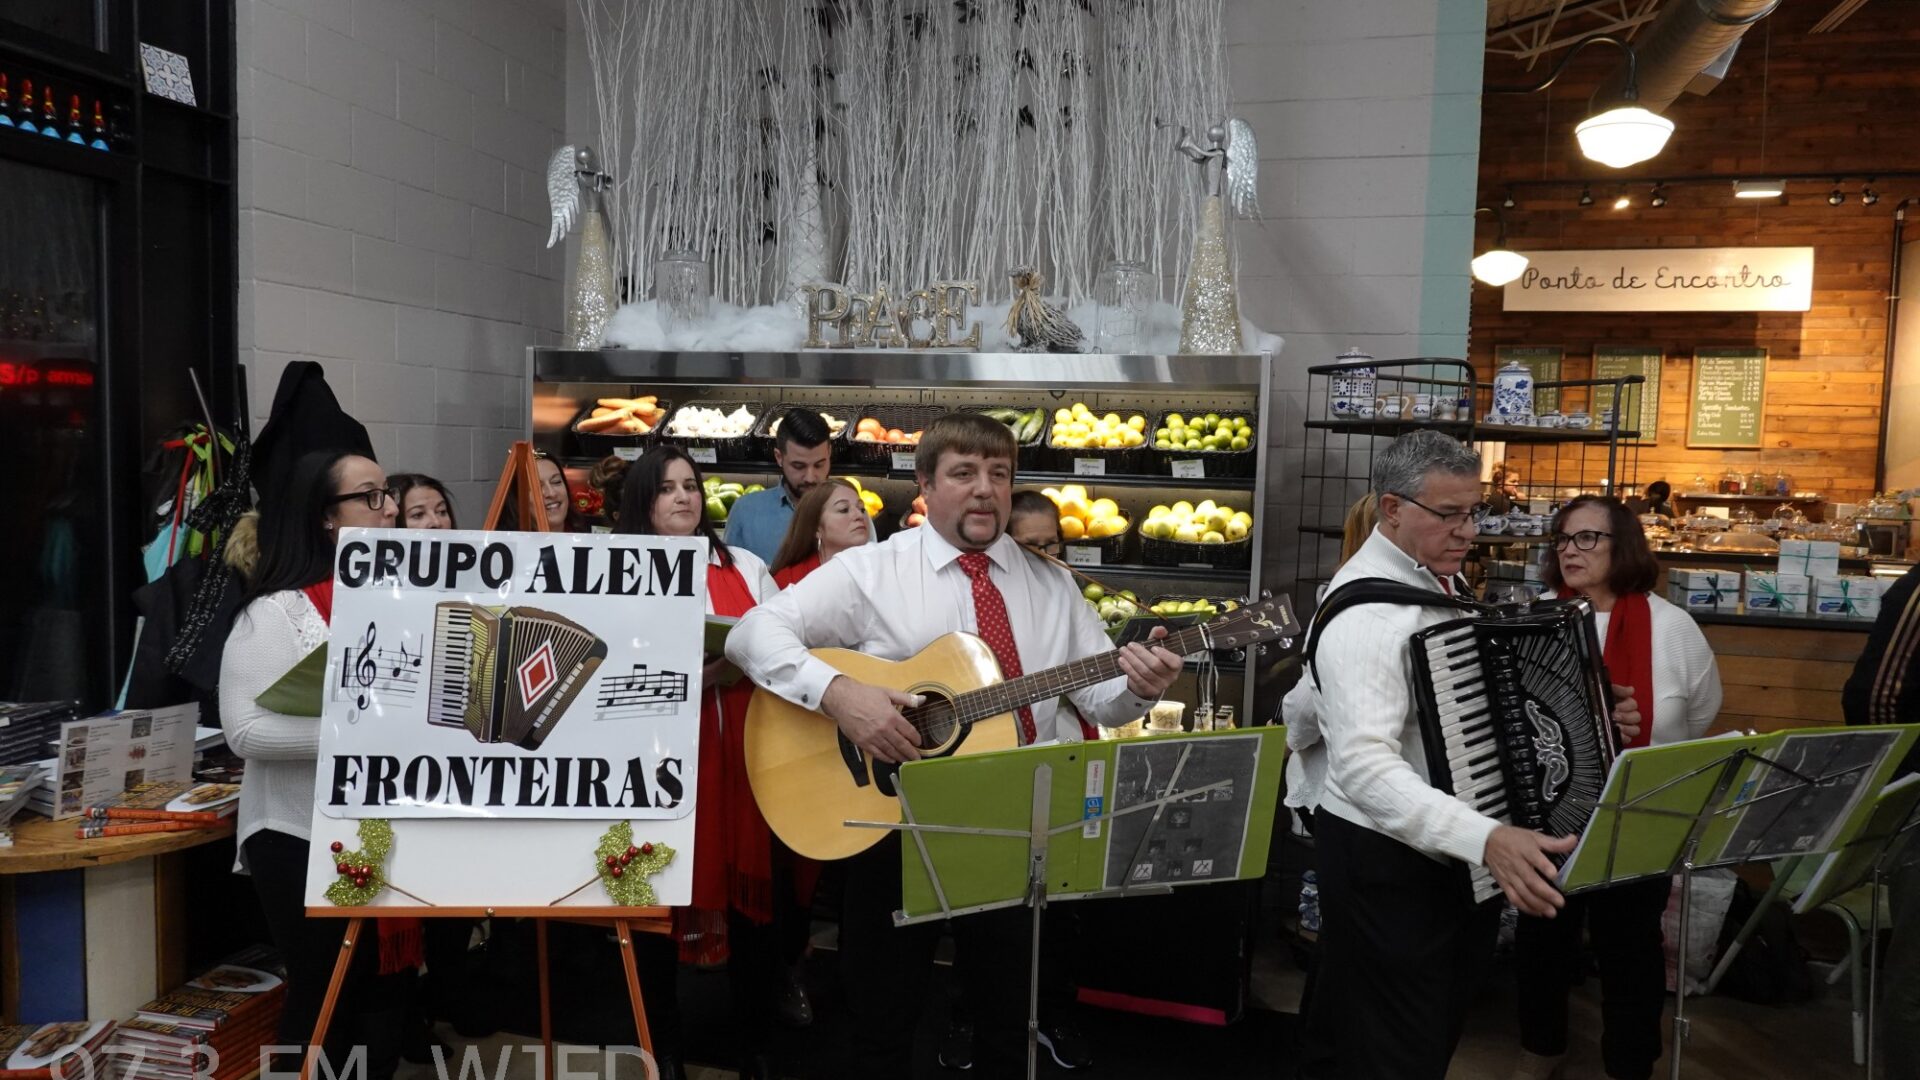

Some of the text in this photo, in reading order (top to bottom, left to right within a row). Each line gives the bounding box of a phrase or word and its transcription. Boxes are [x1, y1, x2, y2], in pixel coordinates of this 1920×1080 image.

[1521, 264, 1792, 290] Ponto de Encontro
[800, 280, 982, 349] PEACE
[338, 539, 698, 597] GRUPO ALEM
[327, 754, 685, 809] FRONTEIRAS
